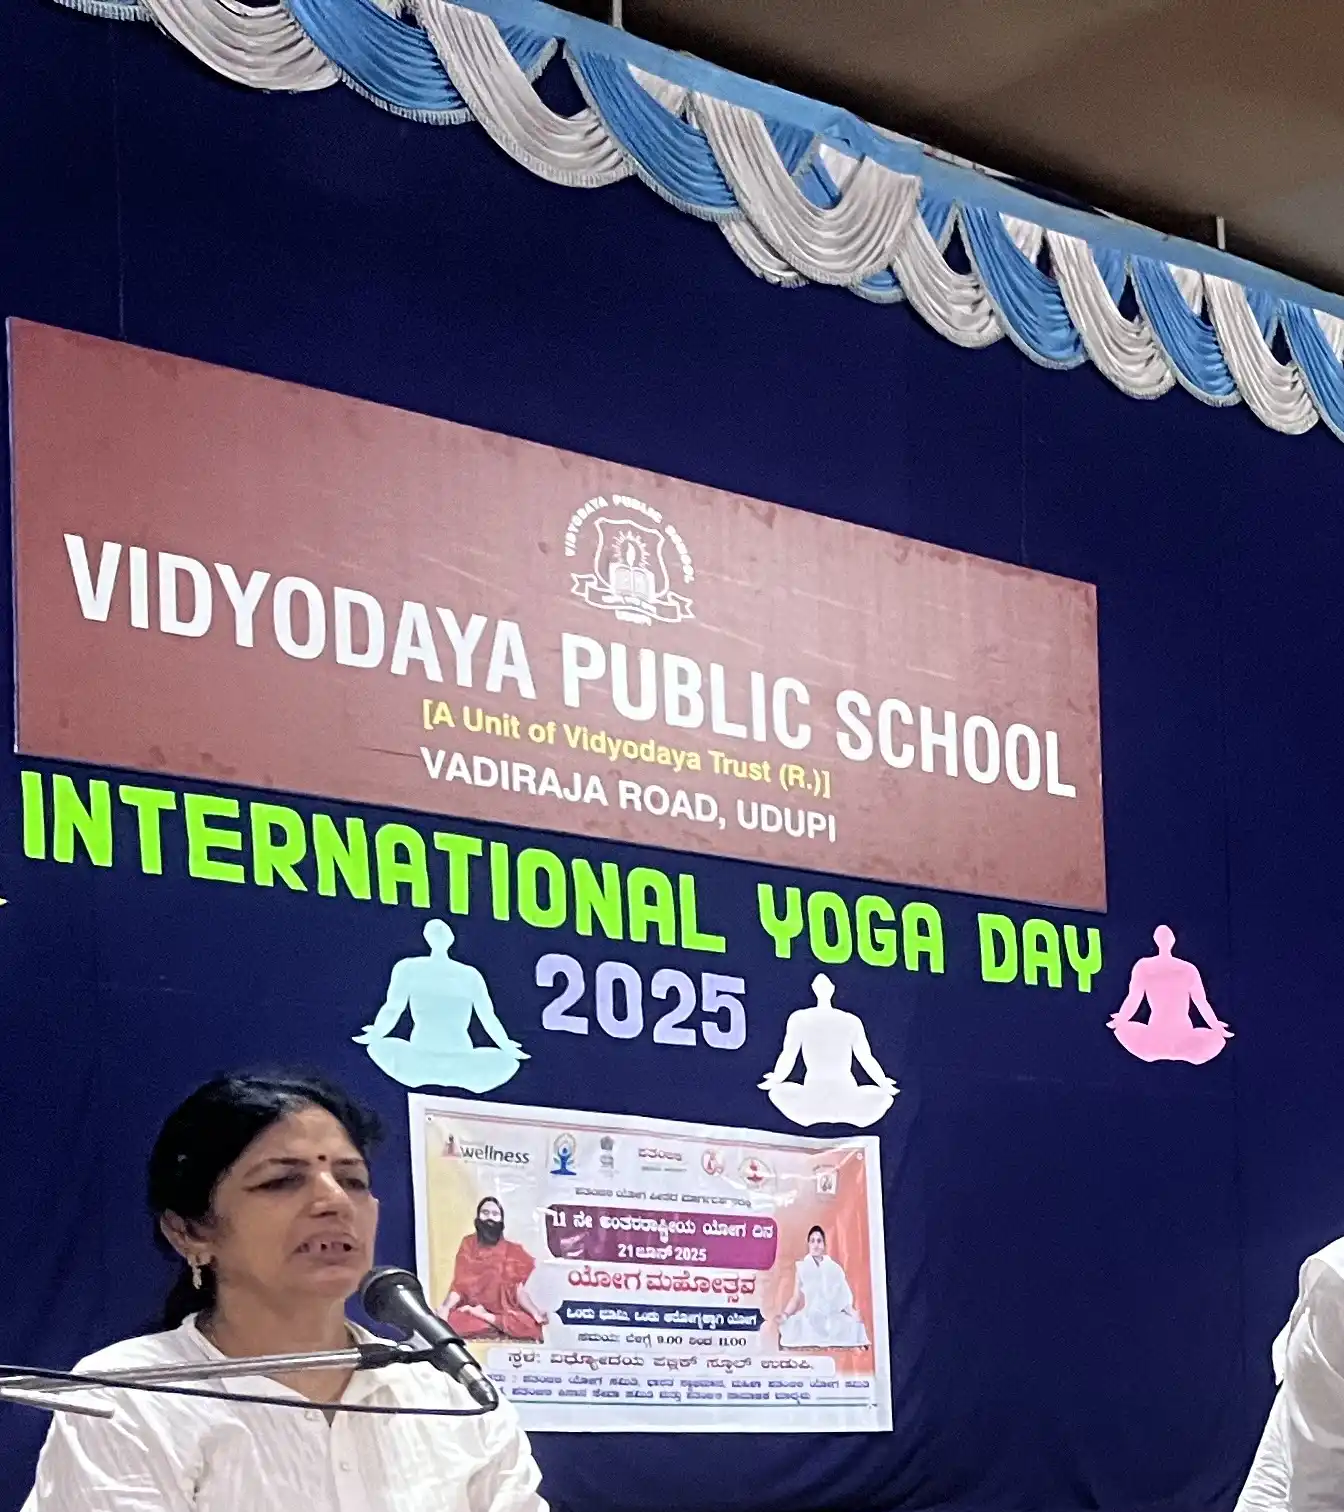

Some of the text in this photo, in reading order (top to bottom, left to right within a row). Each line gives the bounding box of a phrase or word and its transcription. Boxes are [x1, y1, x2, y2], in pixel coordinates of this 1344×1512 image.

[63, 533, 1076, 798] VIDYODAYA PUBLIC SCHOOL
[423, 699, 831, 798] [A Unit of Vidyodaya Trust (R.)]
[420, 746, 837, 843] VADIRAJA ROAD, UDUPI
[21, 771, 1102, 993] INTERNATIONAL YOGA DAY
[535, 952, 746, 1050] 2025
[460, 1145, 530, 1164] wellness
[617, 1244, 633, 1258] 21
[675, 1247, 707, 1262] 2025
[702, 1220, 746, 1238] ಯೋಗ
[568, 1265, 756, 1303] ಯೋಗ ಮಹೋತ್ಸವ
[657, 1335, 682, 1345] 9.00
